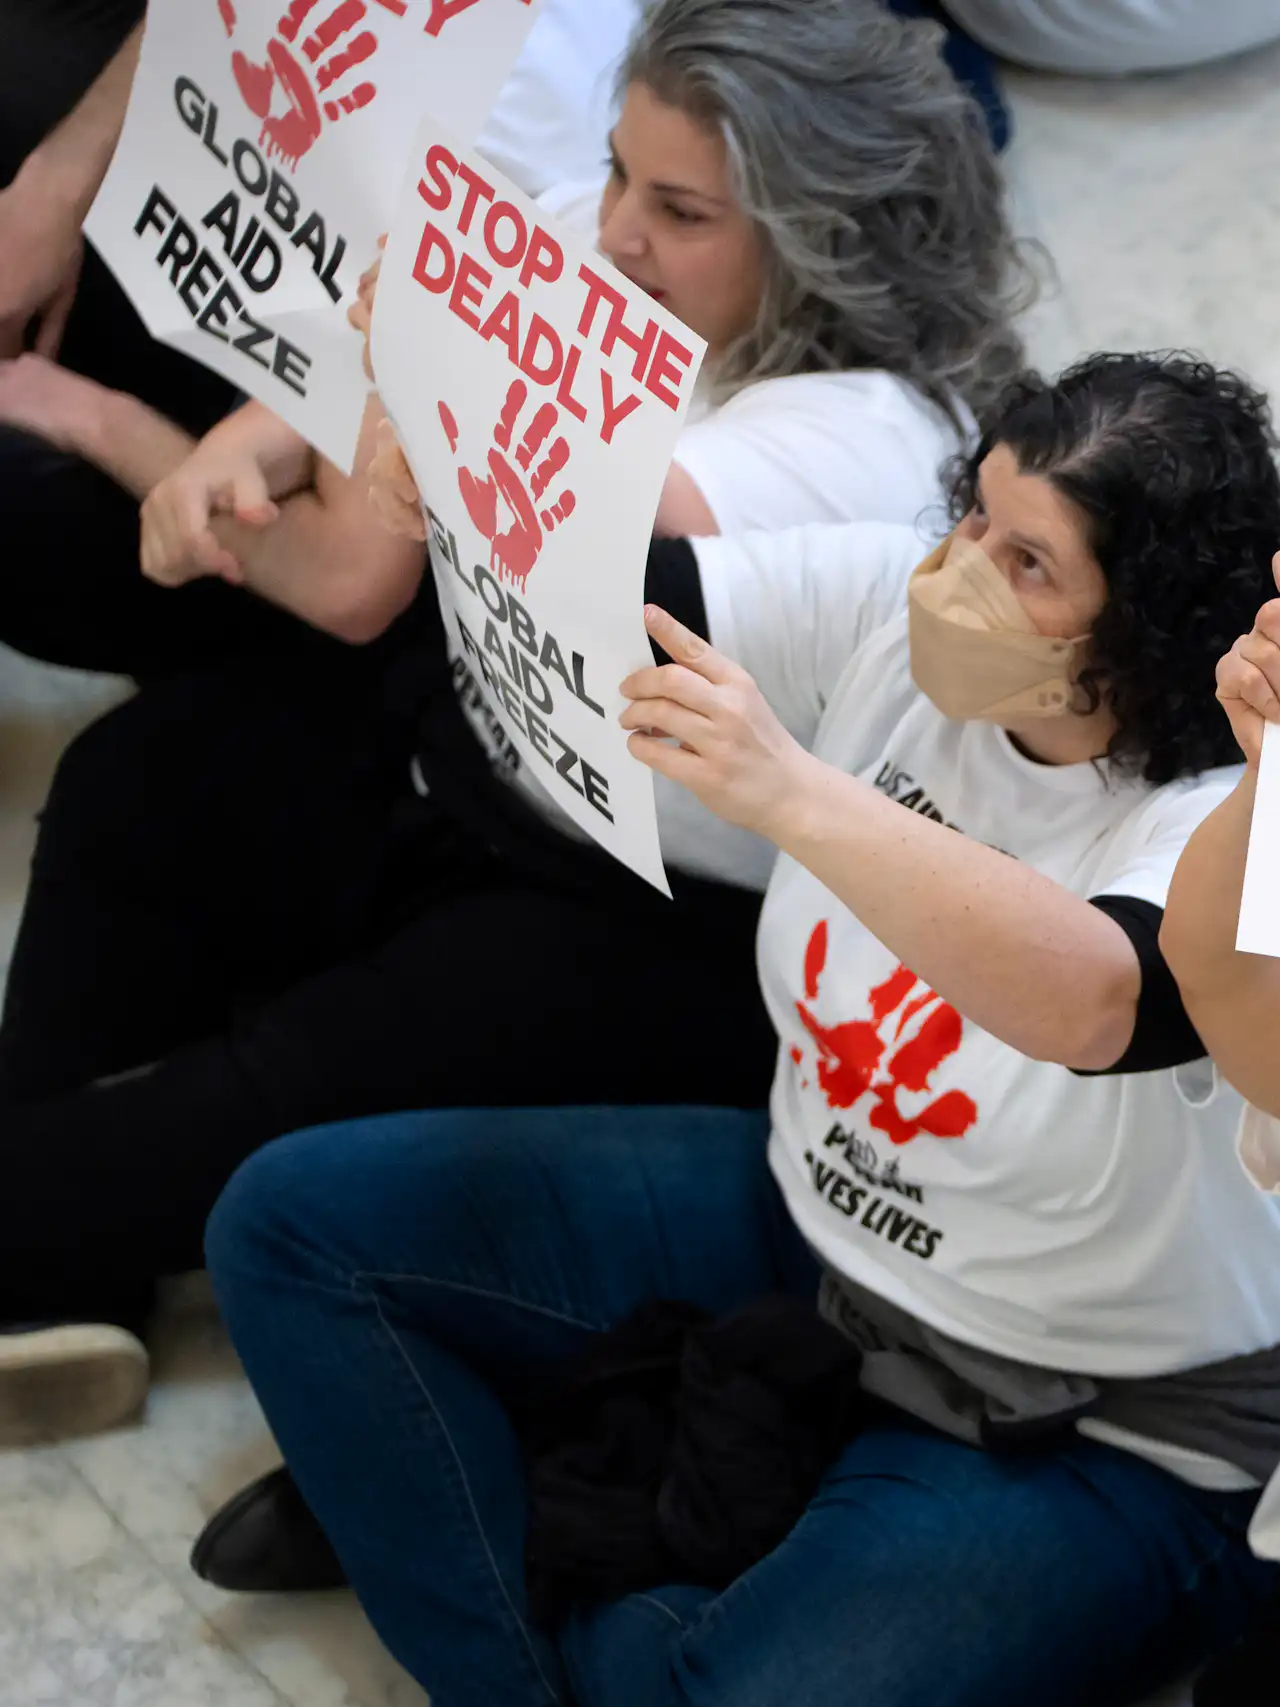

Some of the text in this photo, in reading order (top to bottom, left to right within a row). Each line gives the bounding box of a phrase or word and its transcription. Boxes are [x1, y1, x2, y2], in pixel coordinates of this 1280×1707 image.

[134, 183, 312, 399] FREEZE
[174, 74, 347, 304] GLOBAL
[202, 190, 283, 294] AID
[417, 144, 694, 412] STOP THE
[412, 220, 643, 445] DEADLY
[426, 503, 606, 719] GLOBAL
[454, 607, 615, 825] FREEZE
[484, 615, 554, 715] AID
[861, 1196, 944, 1260] LIVES
